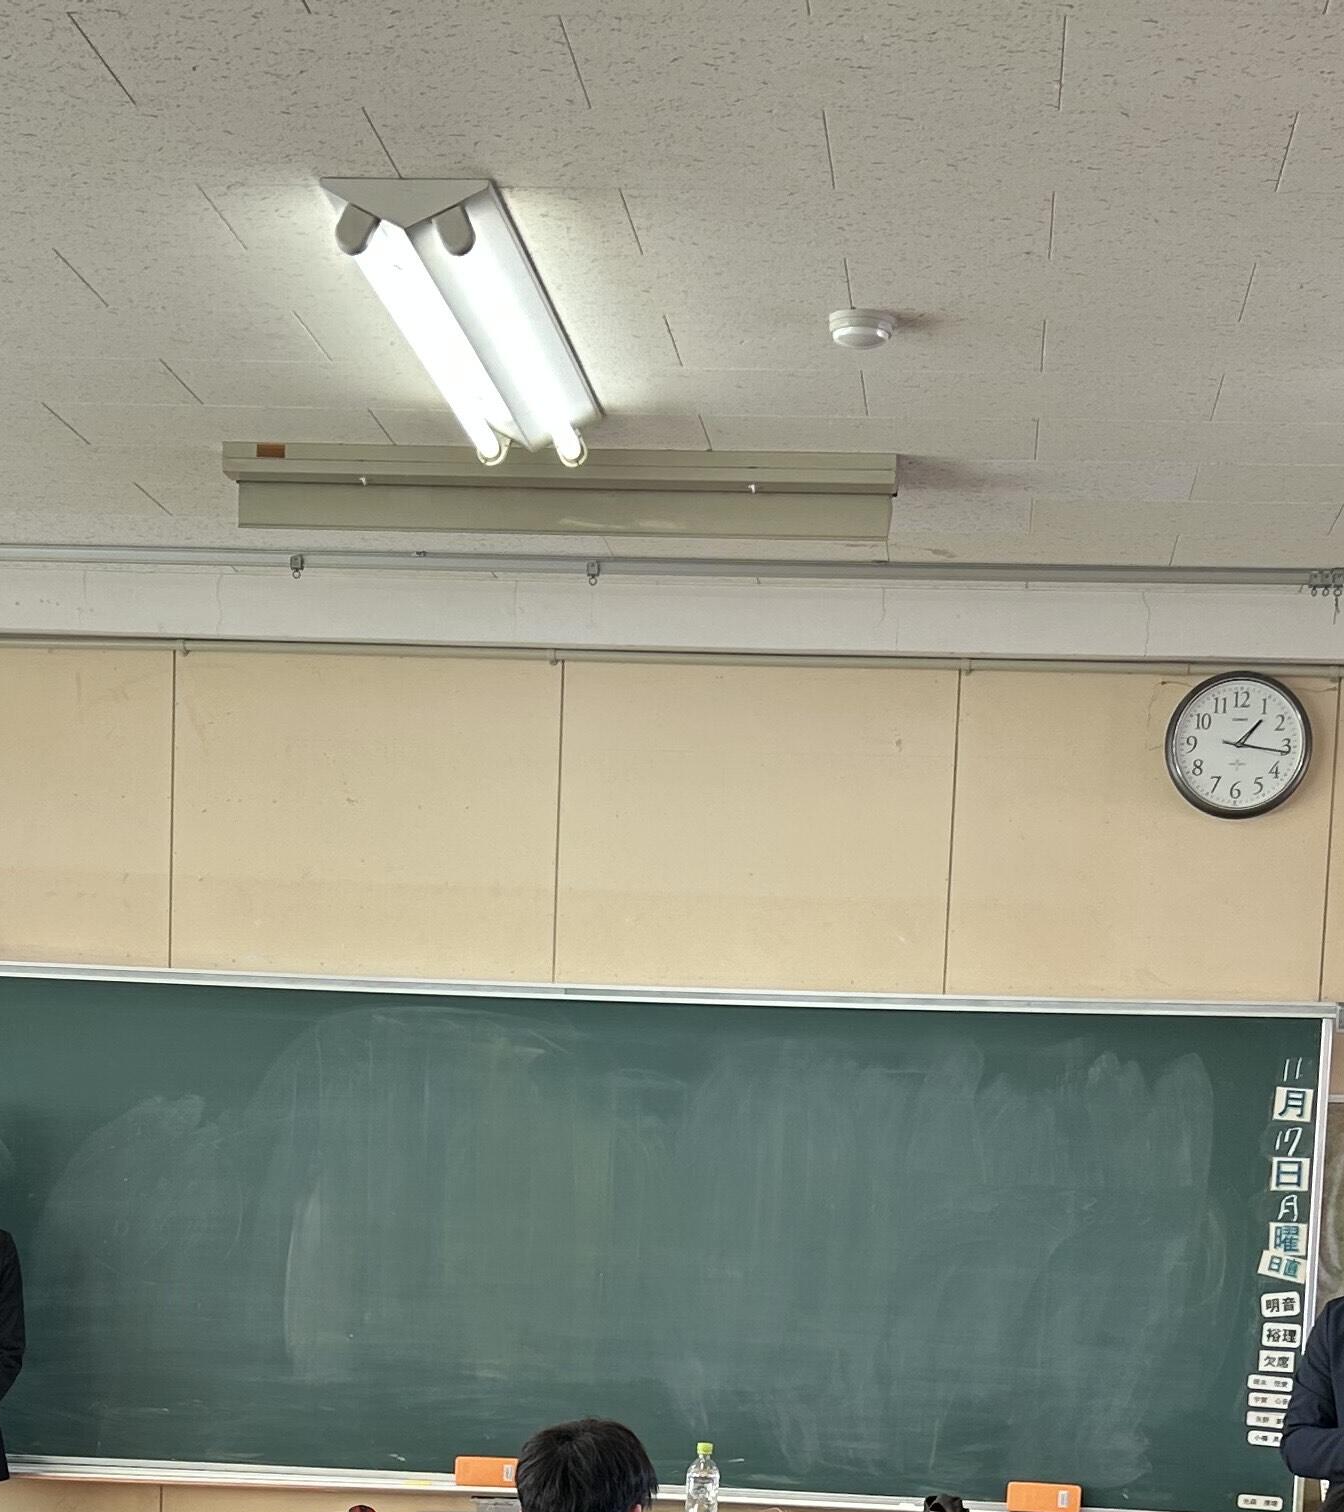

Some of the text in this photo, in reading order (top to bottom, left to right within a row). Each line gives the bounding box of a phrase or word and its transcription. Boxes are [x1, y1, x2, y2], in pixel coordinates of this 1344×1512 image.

[1213, 697, 1227, 714] 11
[1232, 690, 1250, 708] 12
[1261, 698, 1267, 714] 1
[1195, 713, 1212, 730] 10
[1274, 714, 1285, 731] 2
[1186, 735, 1198, 754] 9
[1280, 738, 1292, 756] 3
[1191, 758, 1204, 776] 8
[1268, 761, 1280, 779] 4
[1210, 775, 1222, 794] 7
[1229, 781, 1241, 799] 6
[1253, 776, 1263, 795] 5
[1267, 1255, 1301, 1278] 日直
